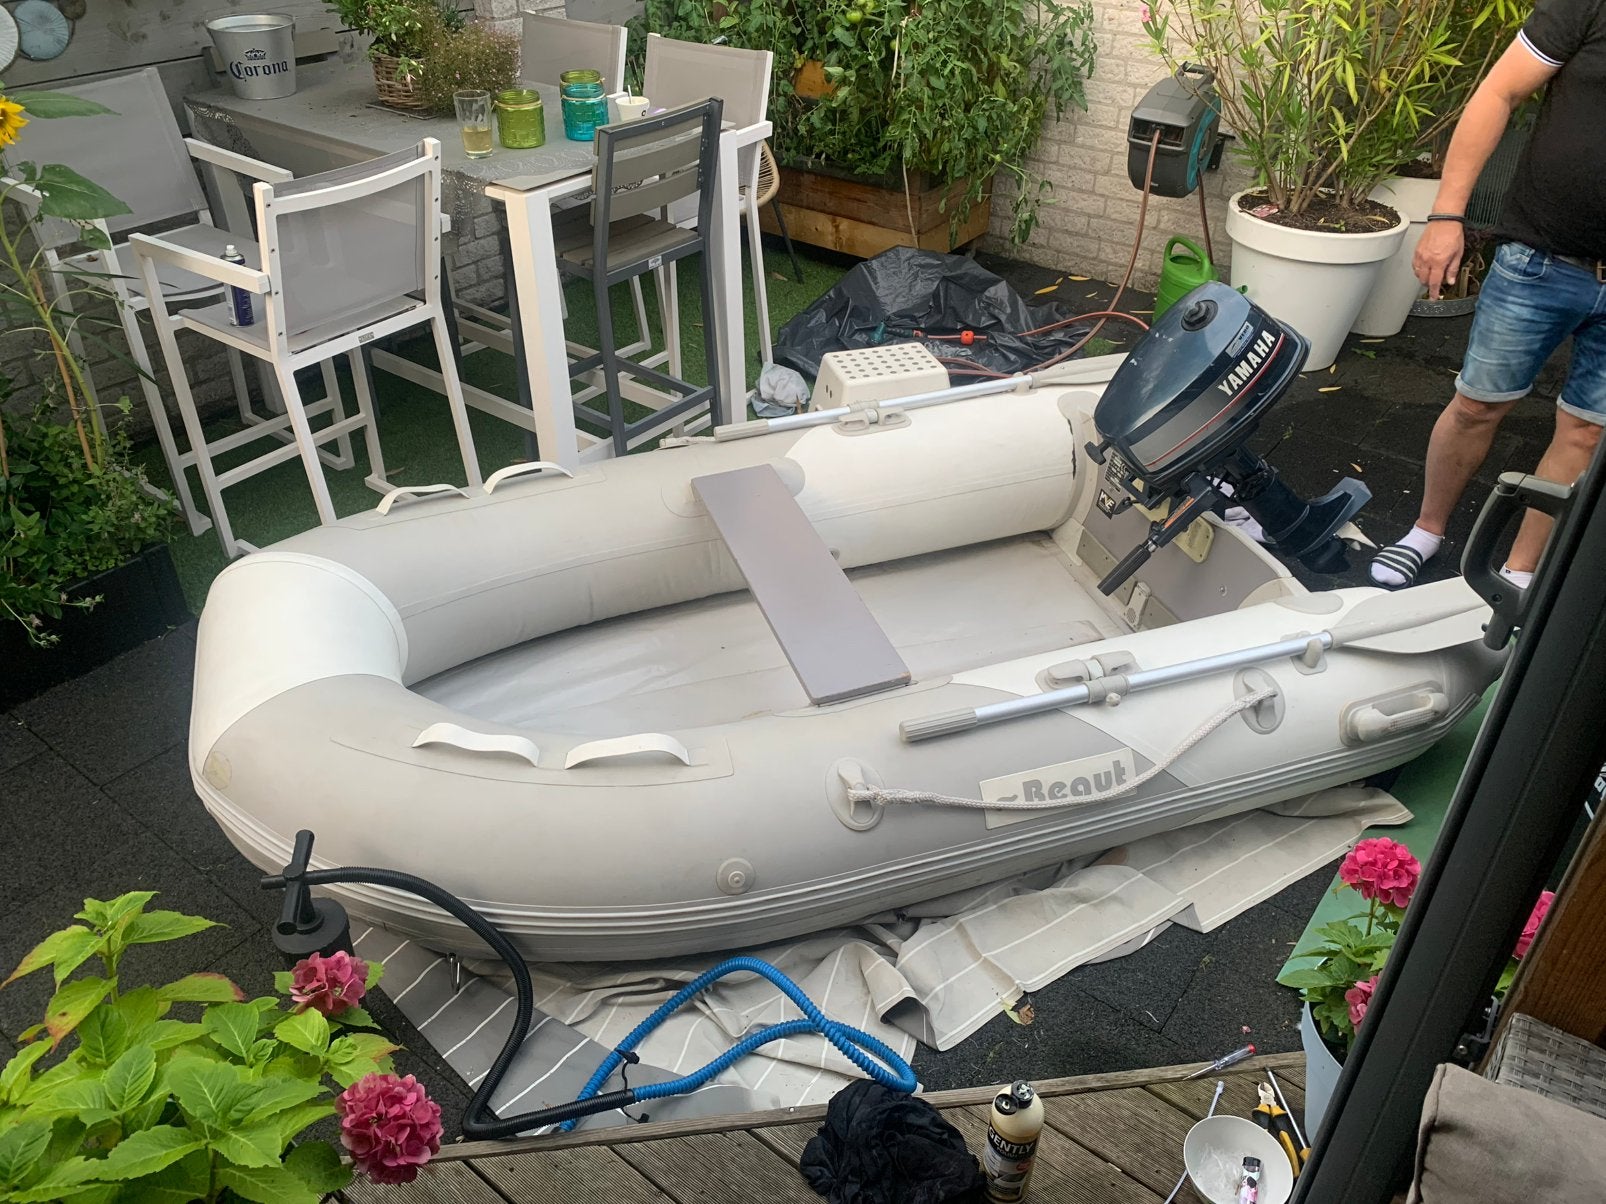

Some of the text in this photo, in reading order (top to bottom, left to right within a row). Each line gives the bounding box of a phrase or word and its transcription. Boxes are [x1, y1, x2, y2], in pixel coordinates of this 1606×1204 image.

[230, 60, 288, 82] Corona
[1217, 330, 1276, 396] YAMAHA
[989, 1126, 1034, 1154] GENTLY
